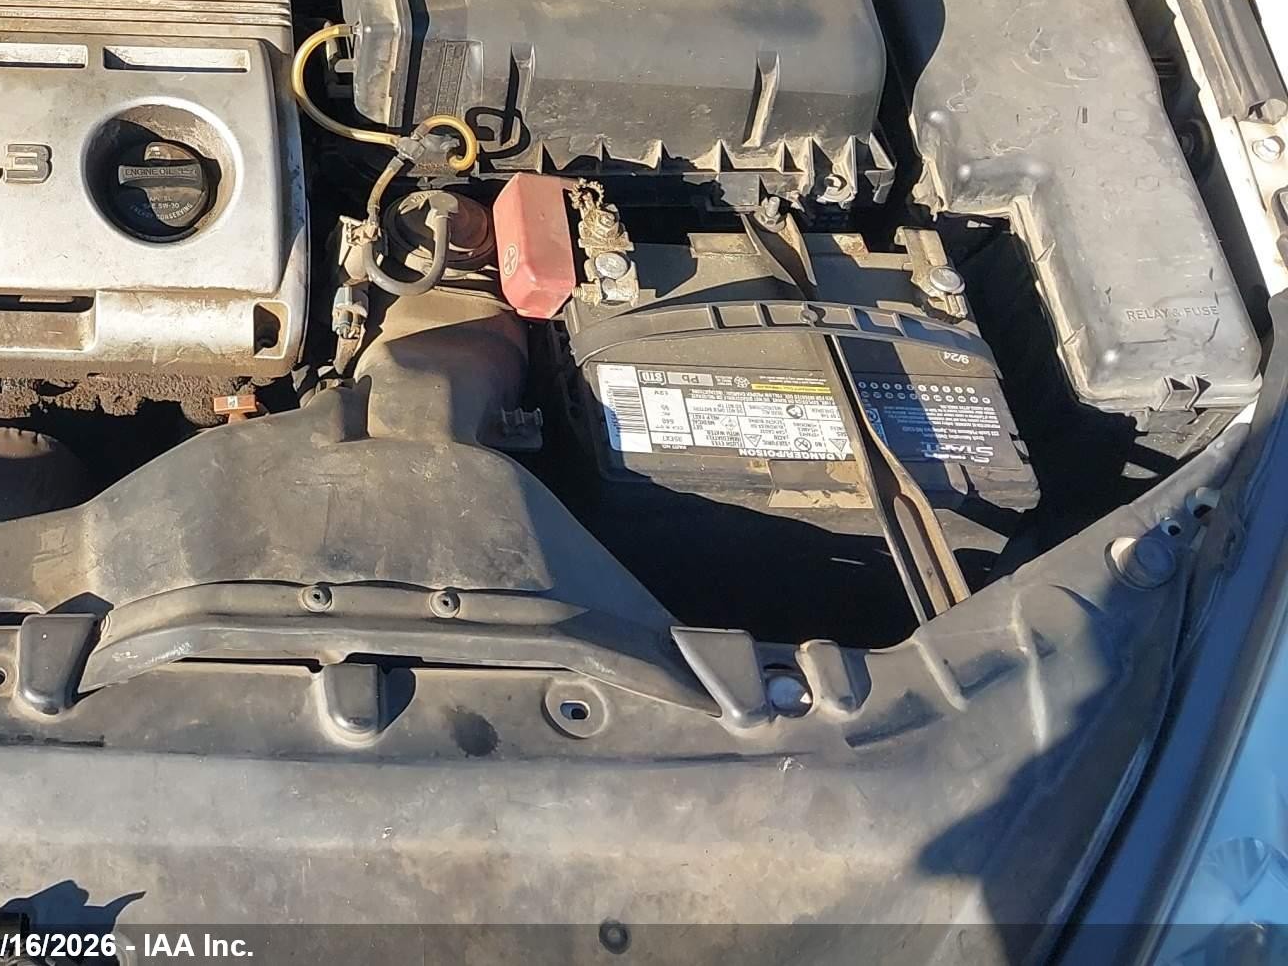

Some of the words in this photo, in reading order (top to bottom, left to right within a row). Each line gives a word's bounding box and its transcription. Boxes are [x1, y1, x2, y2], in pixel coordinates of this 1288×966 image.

[125, 168, 158, 177] ENGINE
[159, 167, 175, 177] OIL
[1126, 308, 1169, 321] RELAY
[1185, 305, 1220, 317] FUSE
[942, 351, 970, 365] 9/24
[681, 374, 700, 384] Pb
[738, 448, 835, 460] DANGER/POISON
